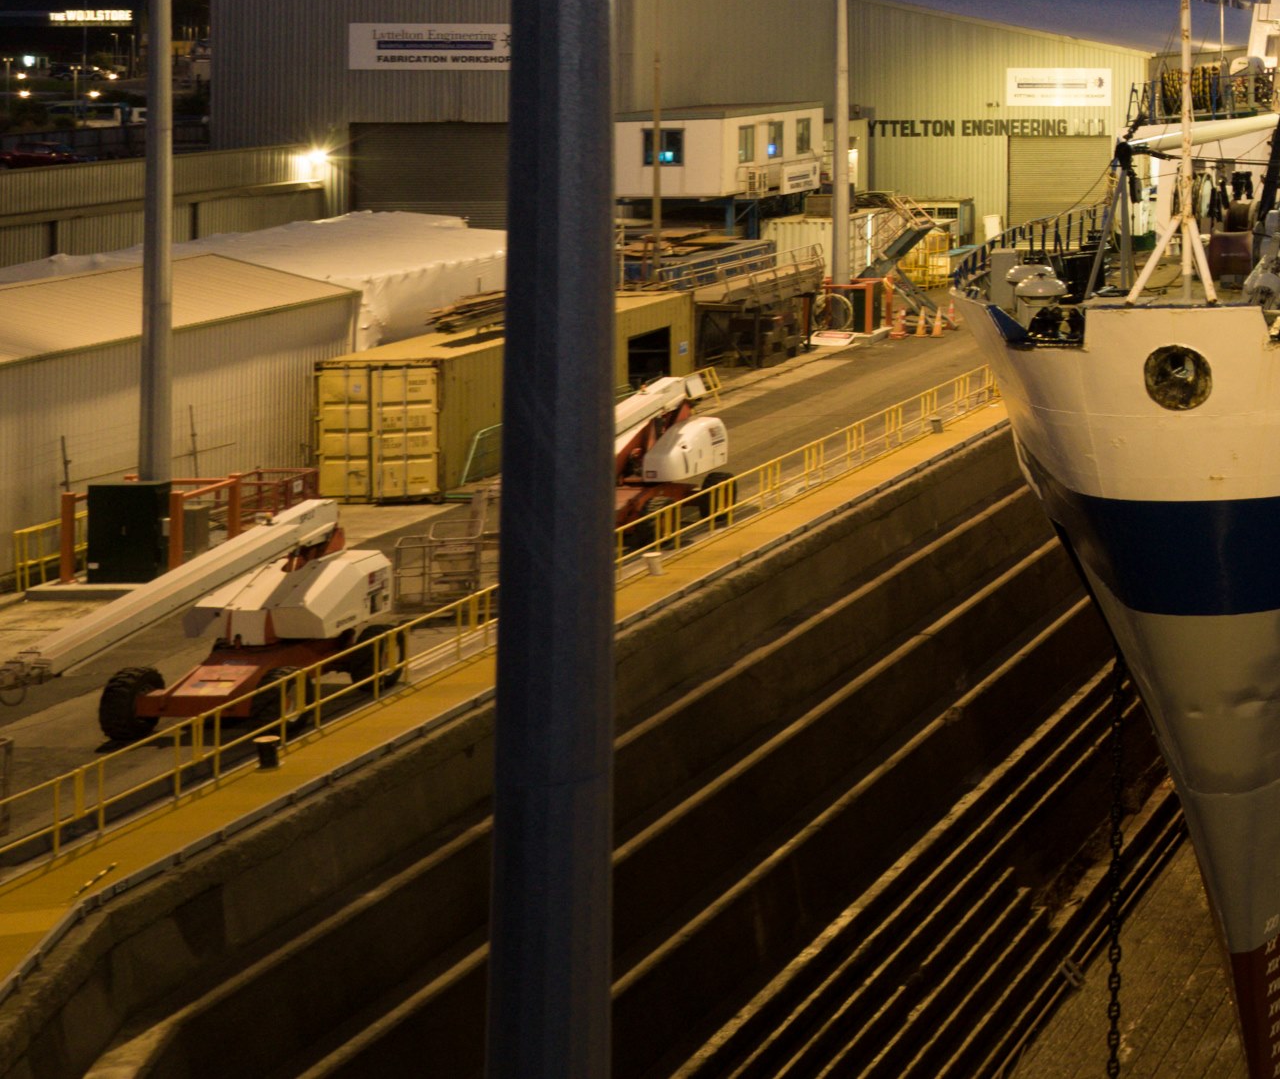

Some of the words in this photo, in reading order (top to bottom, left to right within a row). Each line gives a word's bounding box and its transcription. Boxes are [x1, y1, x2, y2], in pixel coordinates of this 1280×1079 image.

[372, 29, 424, 41] Lyttelton
[428, 29, 497, 43] Engineering
[377, 55, 447, 63] FABRICATION
[961, 119, 1068, 137] ENGINEERING
